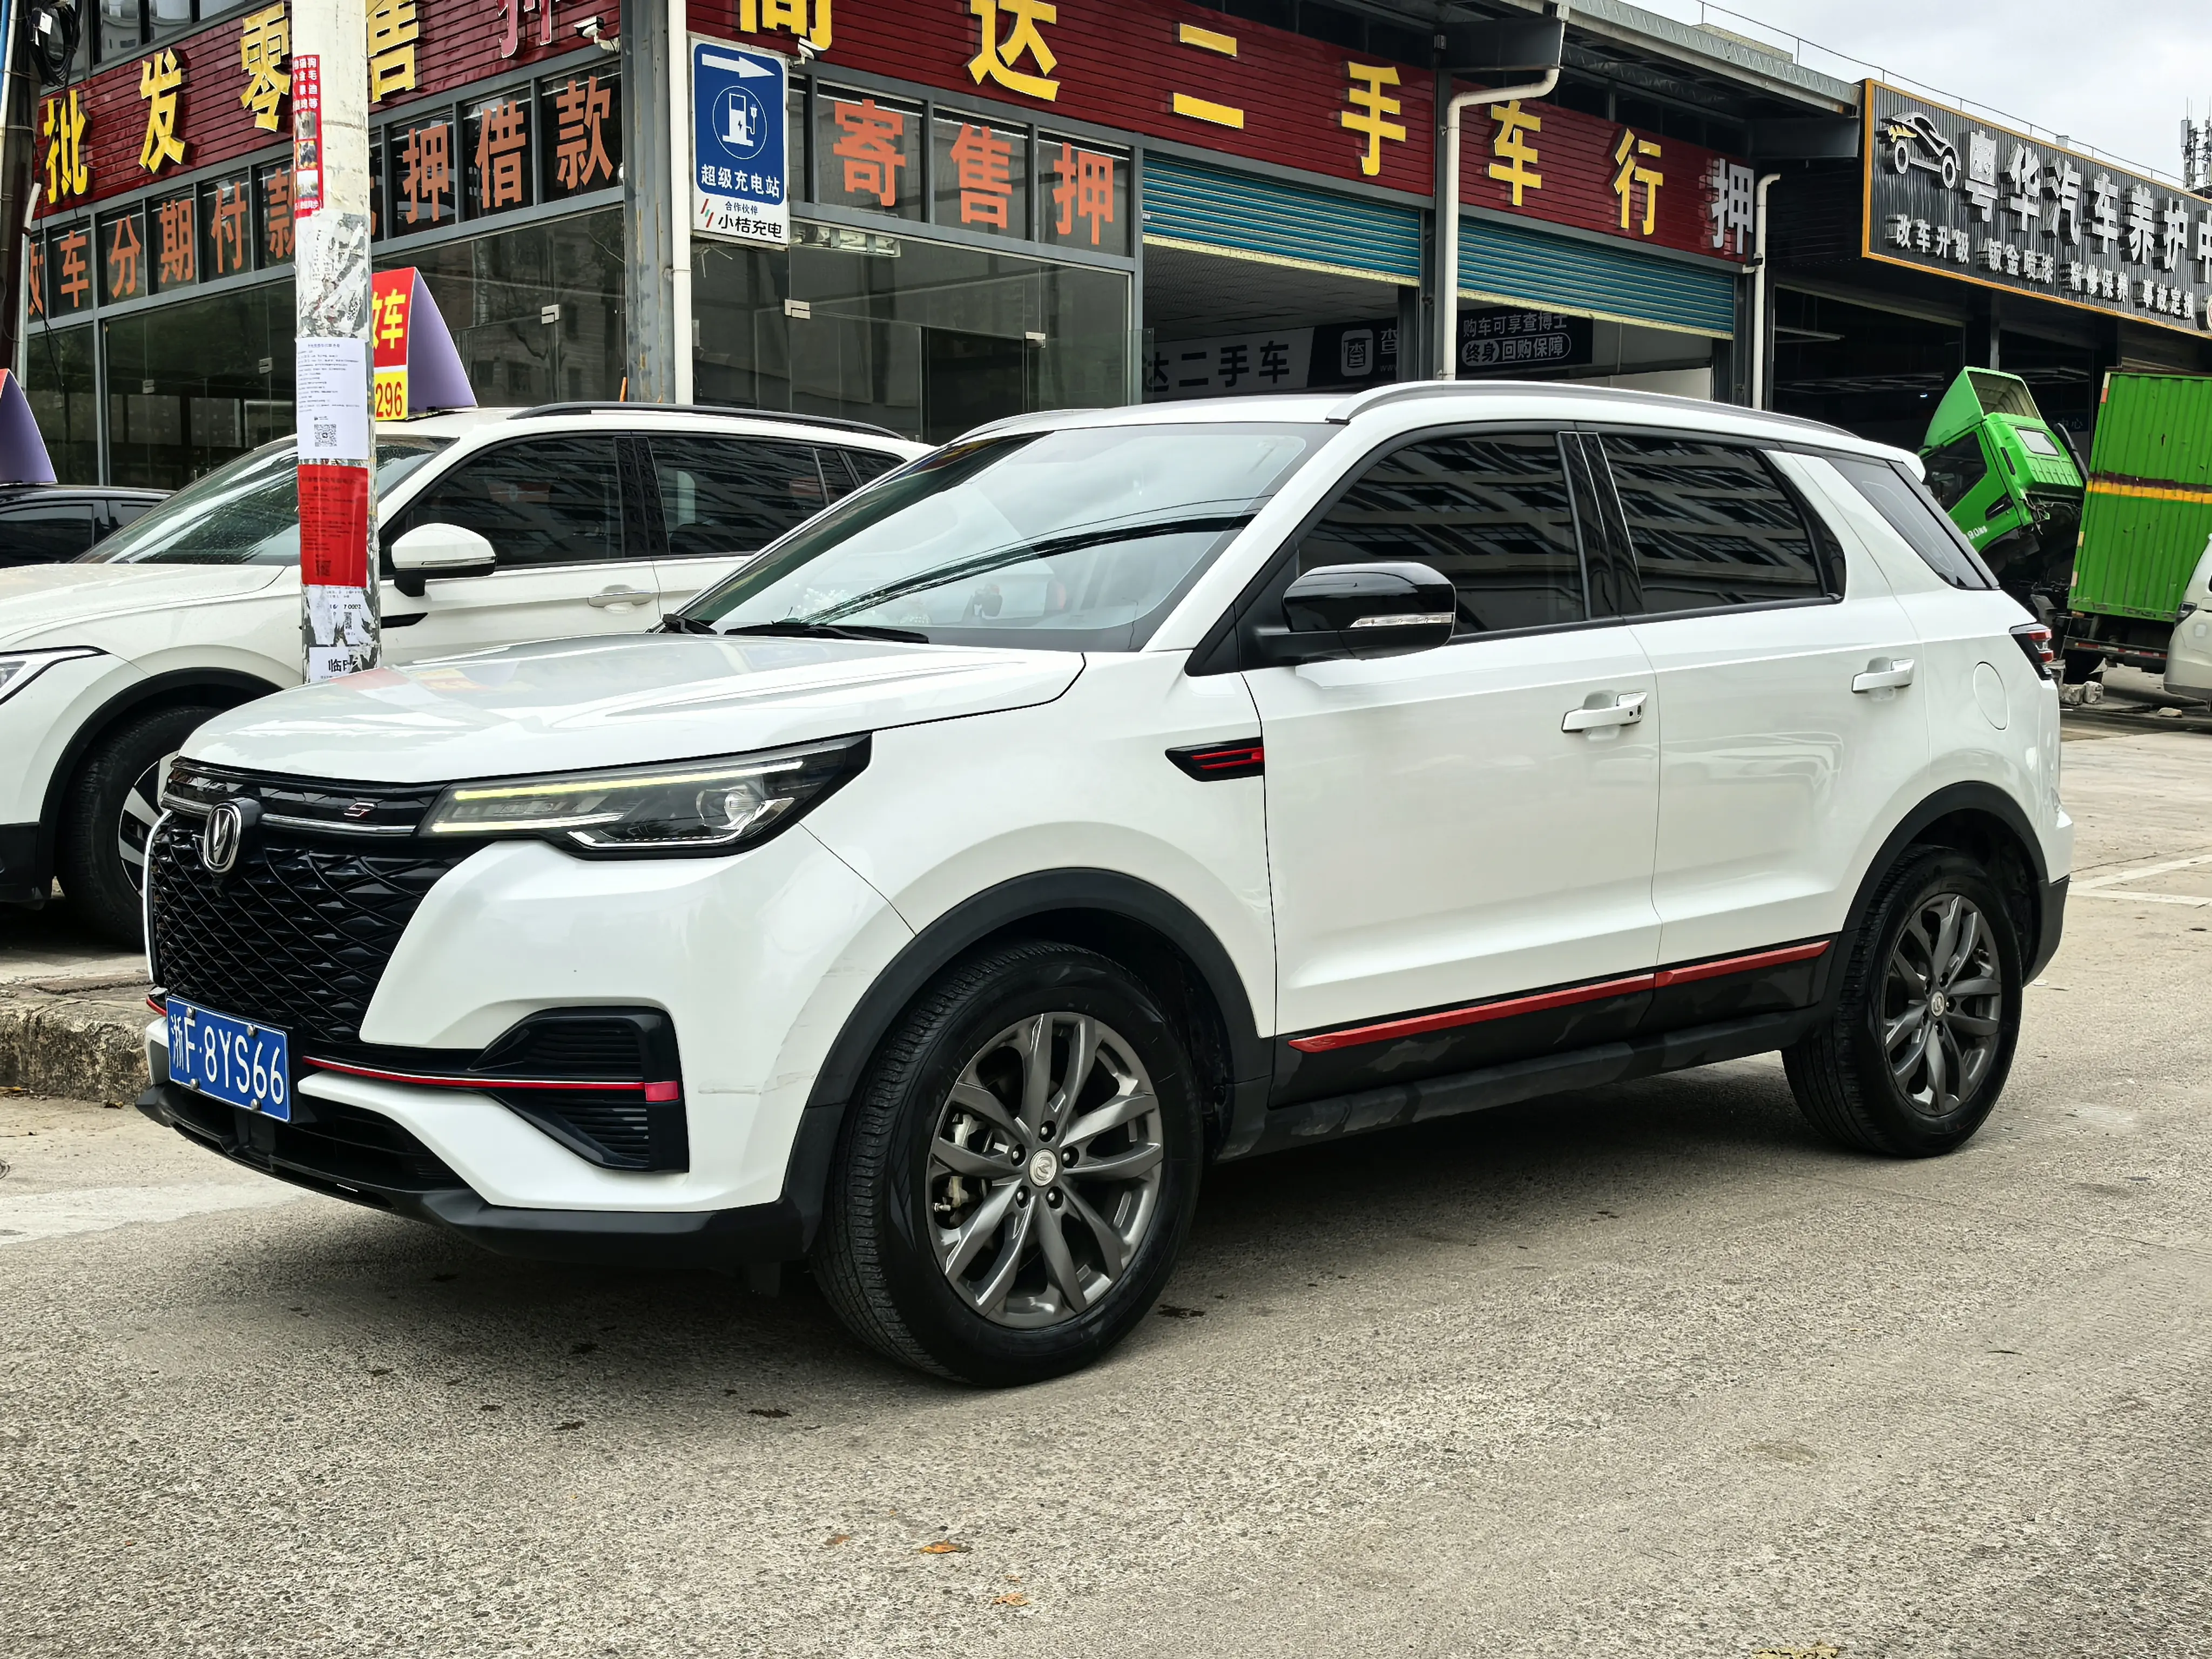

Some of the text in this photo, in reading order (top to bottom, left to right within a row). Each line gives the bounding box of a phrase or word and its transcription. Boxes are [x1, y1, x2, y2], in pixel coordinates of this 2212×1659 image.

[701, 164, 780, 198] 超级充电站
[725, 201, 758, 215] 合作伙伴
[1711, 158, 1755, 254] 押
[718, 214, 782, 238] 小桔充电
[1897, 213, 1970, 264] 改车升级
[1466, 335, 1564, 362] 终身 回购保障
